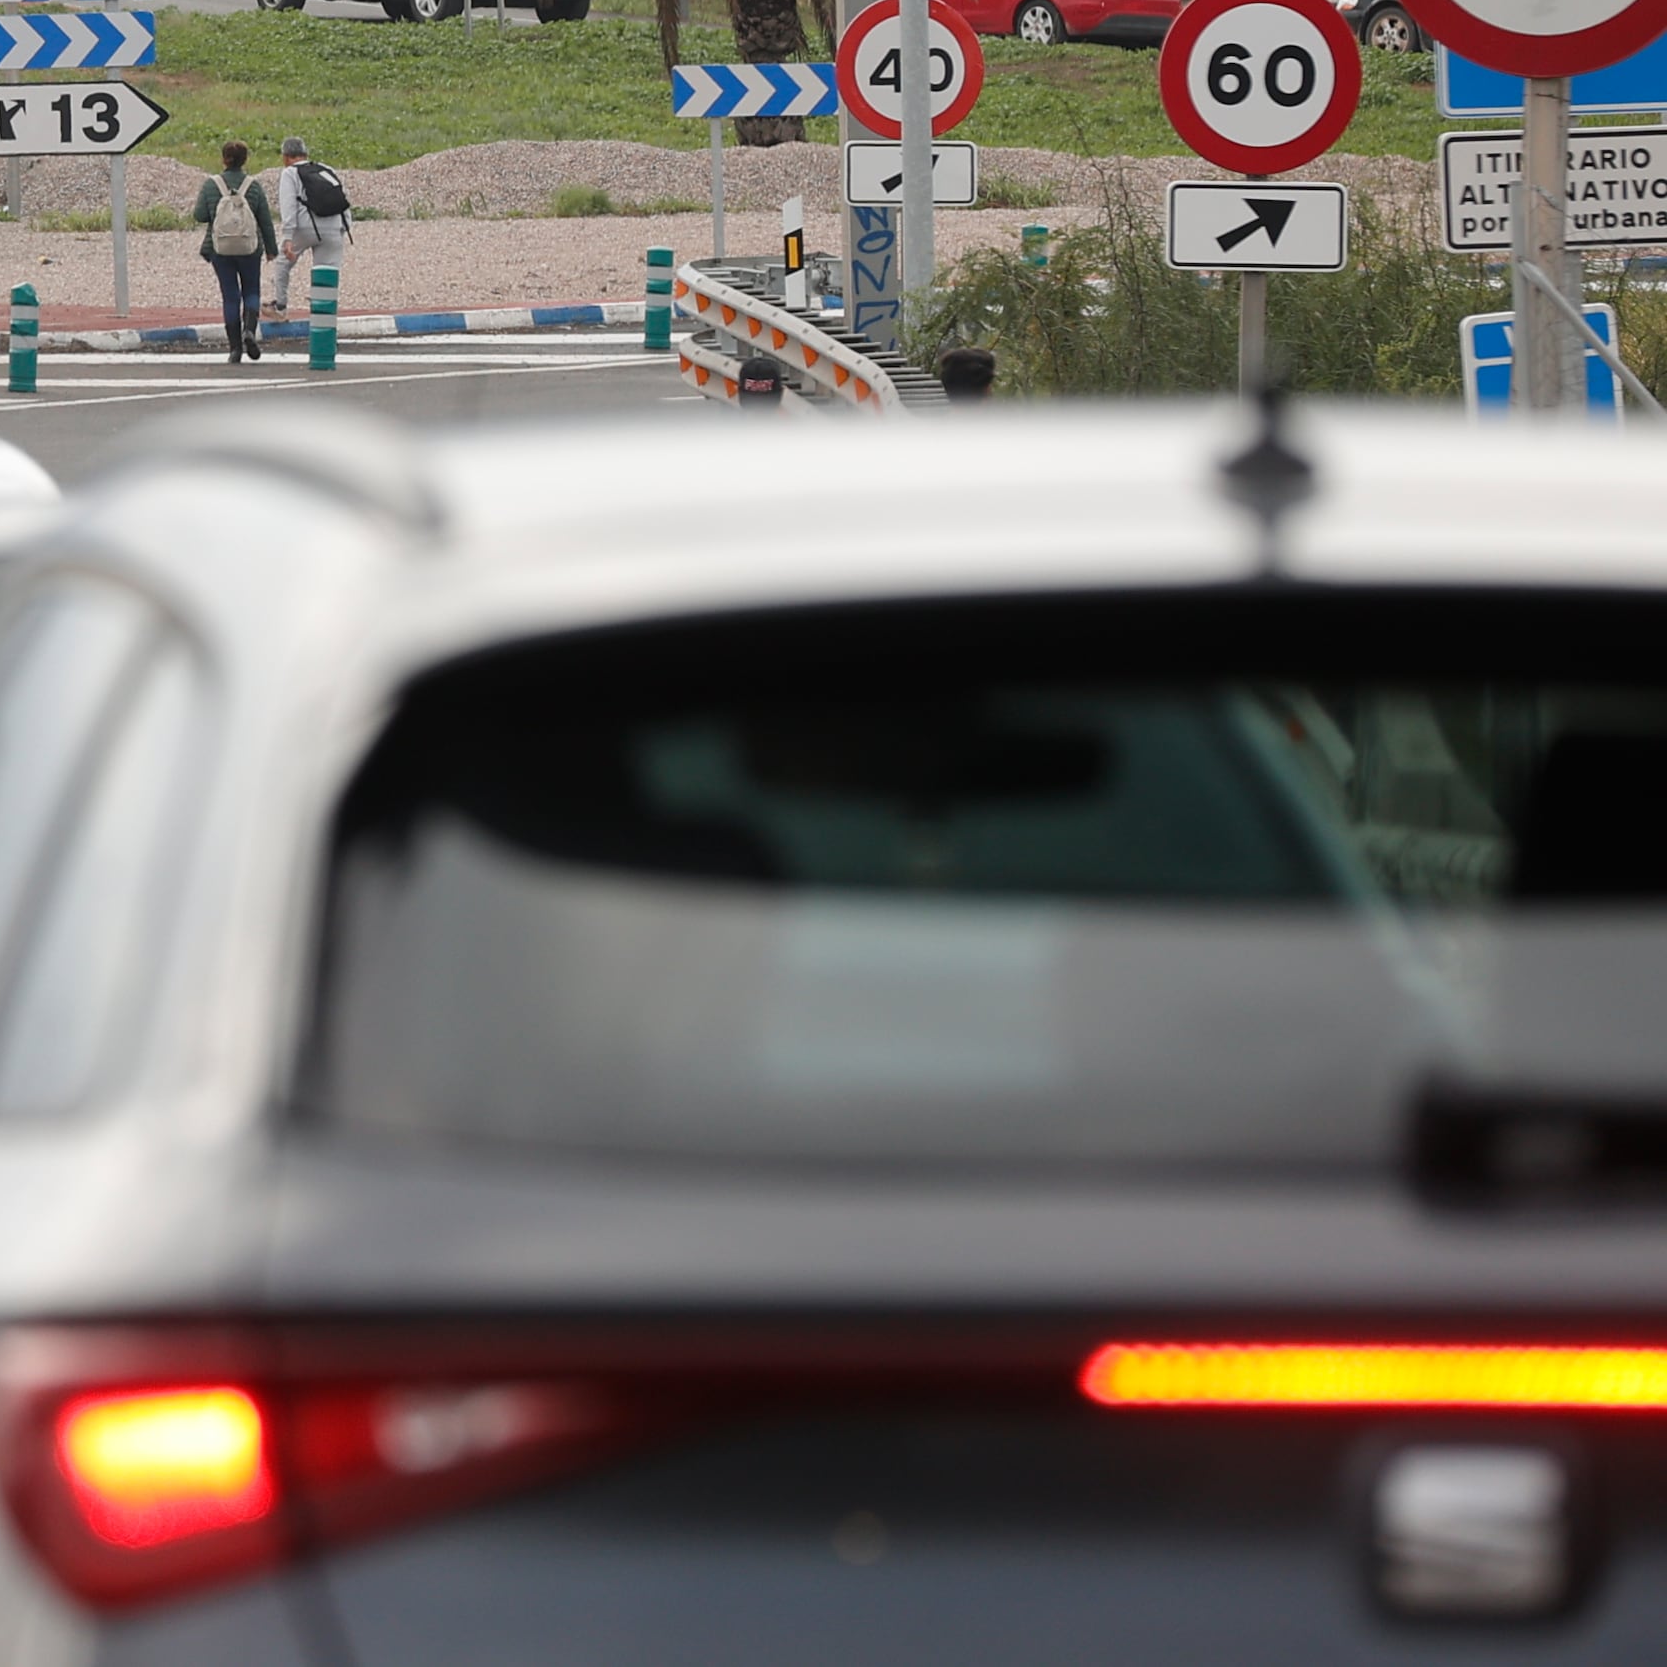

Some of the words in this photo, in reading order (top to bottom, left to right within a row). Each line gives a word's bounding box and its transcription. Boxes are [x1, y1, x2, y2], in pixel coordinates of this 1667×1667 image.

[869, 47, 955, 94] 40
[1207, 42, 1316, 108] 60
[50, 91, 121, 144] 13
[1476, 148, 1651, 174] ITIRARIO
[1459, 178, 1667, 206] ALTNATIVO
[1463, 214, 1510, 238] por
